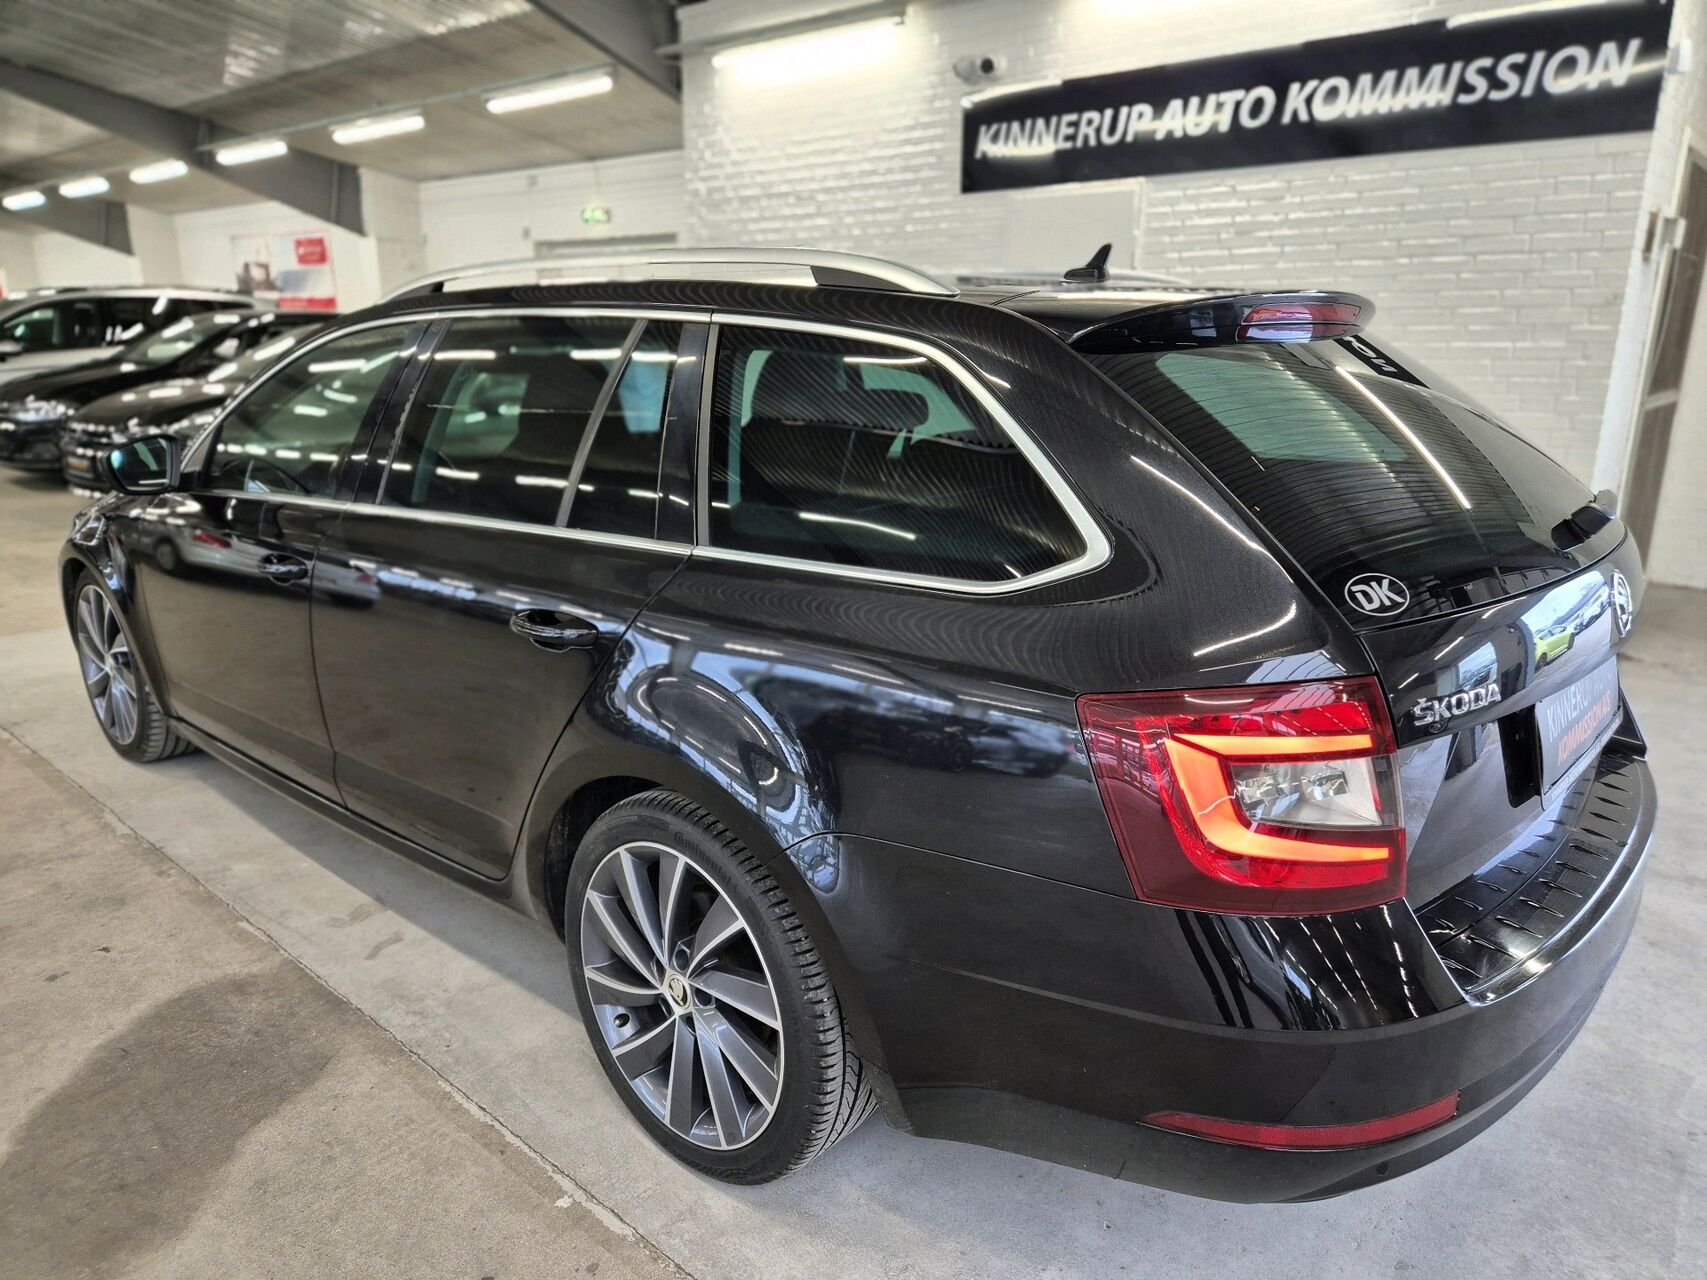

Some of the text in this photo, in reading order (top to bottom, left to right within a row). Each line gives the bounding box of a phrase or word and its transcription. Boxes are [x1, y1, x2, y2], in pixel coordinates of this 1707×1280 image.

[975, 38, 1642, 159] KINNERUP AUTO KOMMISSION
[1350, 578, 1405, 612] DK
[1414, 683, 1502, 726] ŠKODA
